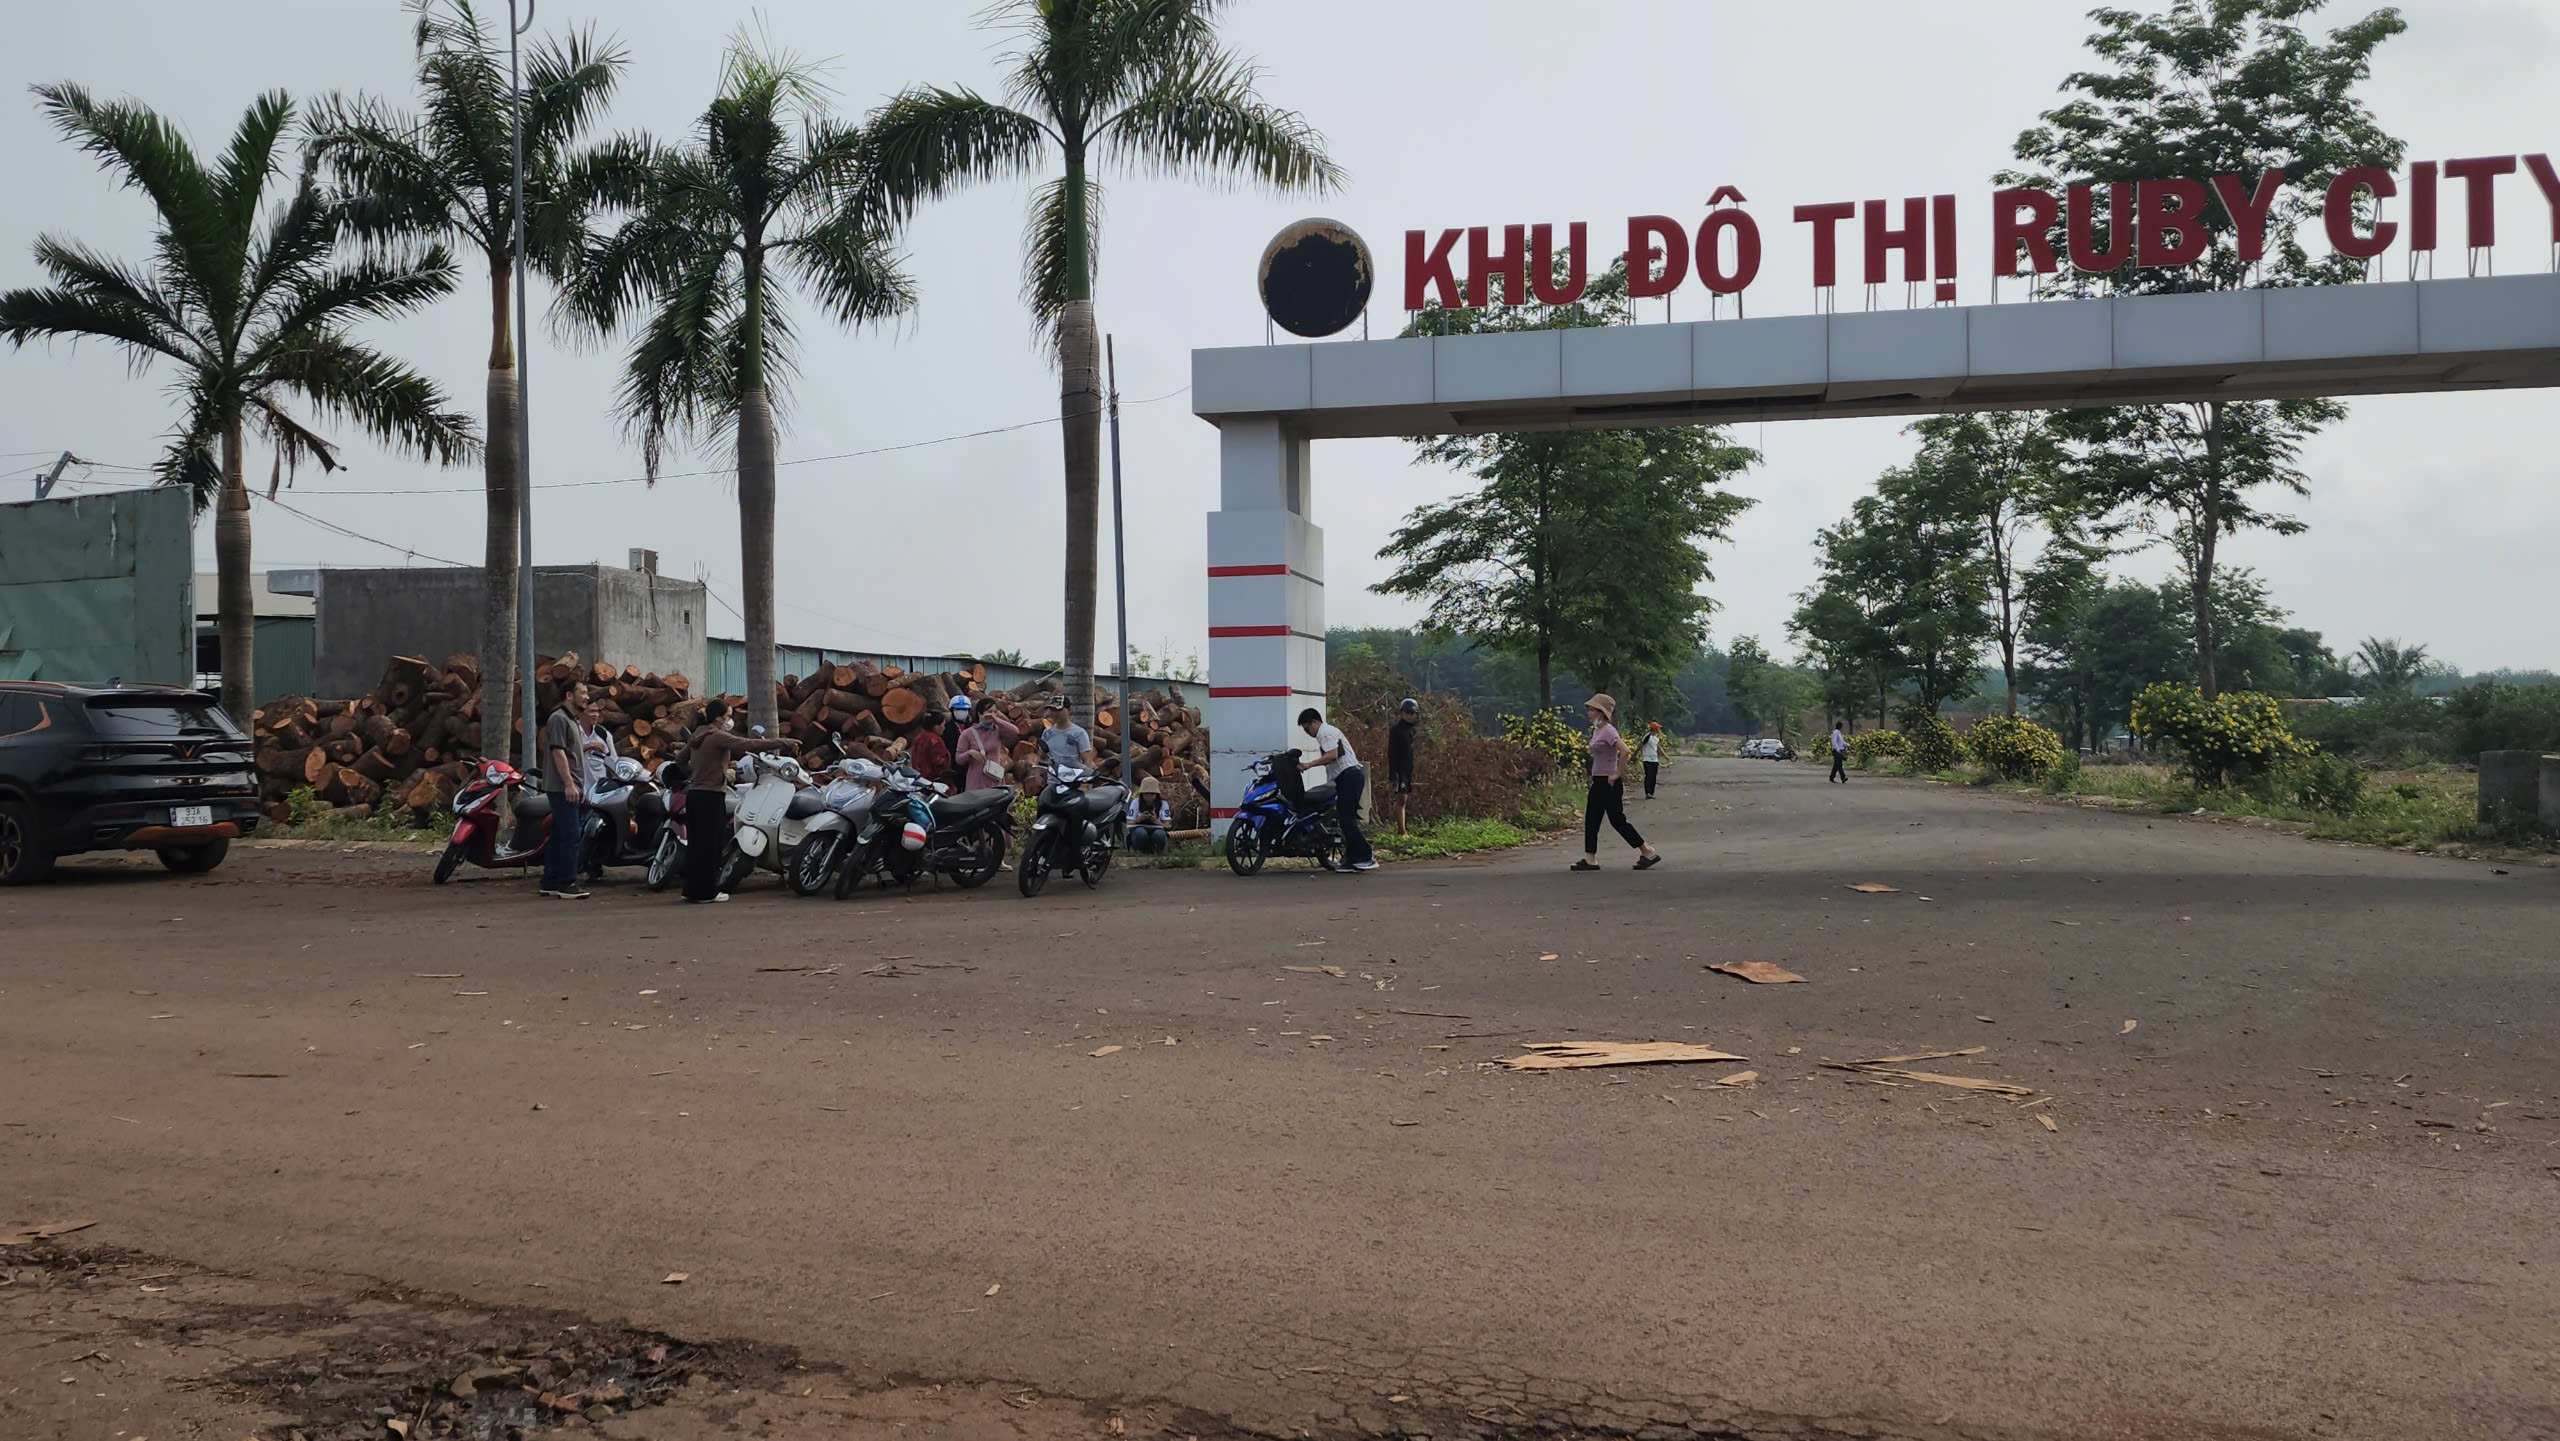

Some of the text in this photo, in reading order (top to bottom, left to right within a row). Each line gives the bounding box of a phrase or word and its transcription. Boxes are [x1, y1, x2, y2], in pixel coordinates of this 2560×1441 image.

[1404, 221, 1588, 311] KHU
[1622, 185, 1762, 299] ĐÔ
[1793, 194, 1957, 301] THỊ
[1993, 169, 2286, 277] RUBY
